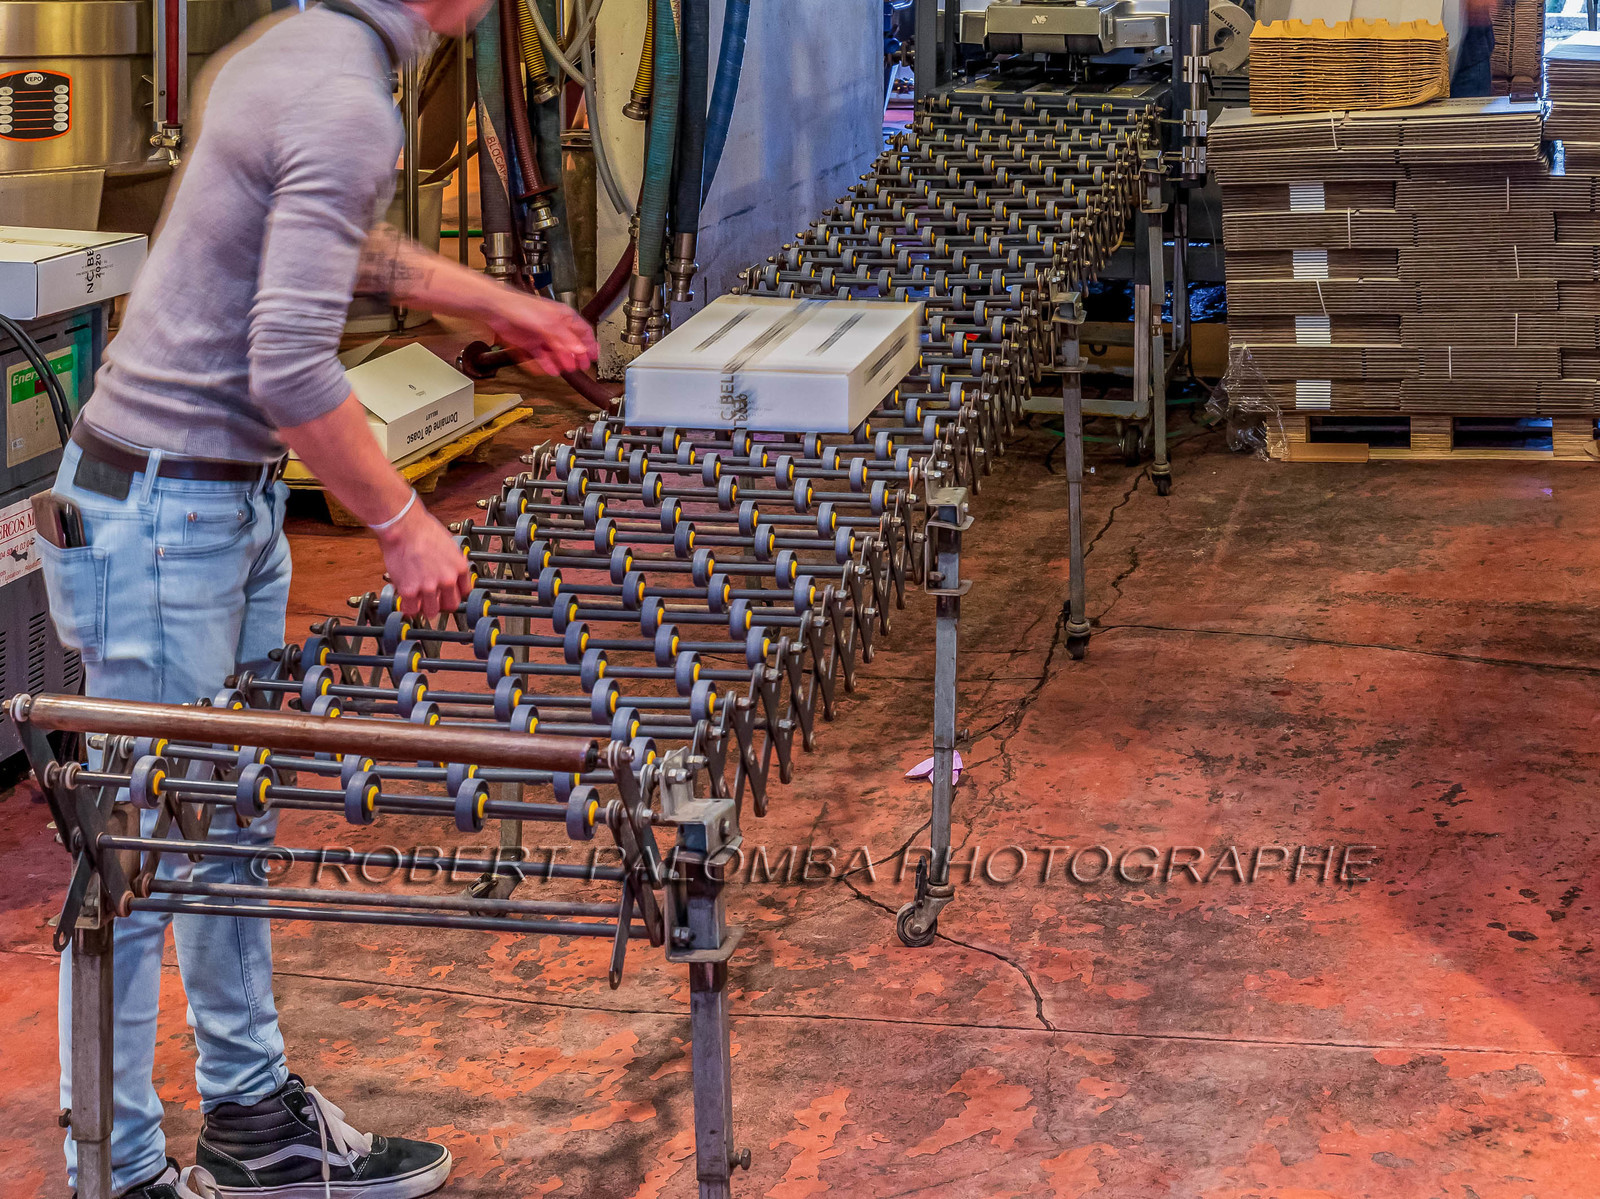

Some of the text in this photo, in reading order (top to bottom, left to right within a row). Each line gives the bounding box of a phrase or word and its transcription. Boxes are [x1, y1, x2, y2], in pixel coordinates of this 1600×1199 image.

[406, 411, 458, 444] Domaine de Toasc
